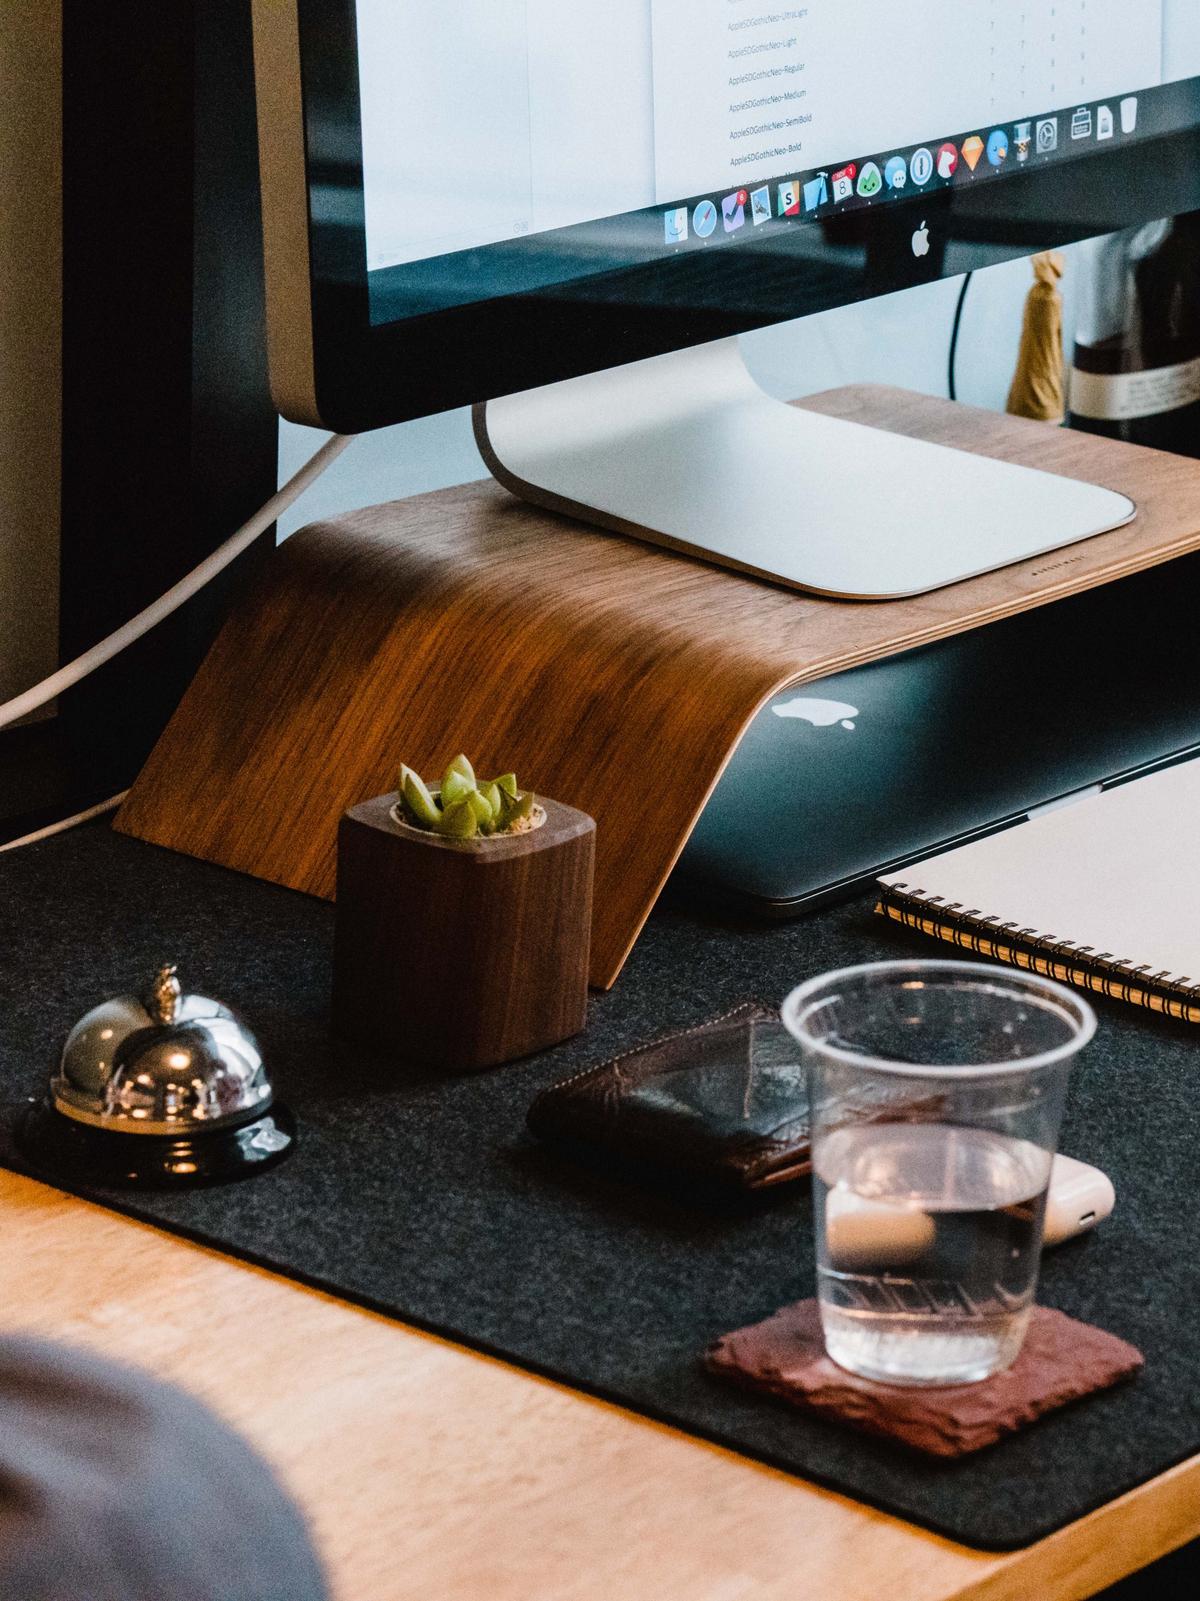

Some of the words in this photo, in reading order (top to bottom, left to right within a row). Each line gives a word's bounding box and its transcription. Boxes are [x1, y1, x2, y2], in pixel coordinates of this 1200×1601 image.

[729, 89, 807, 113] AppleSDGothicNeo-Medium
[729, 114, 813, 139] AppleSDGothicNeo-SemiBold
[730, 142, 802, 166] AppleSDGothicNeo-Bold
[785, 192, 792, 206] S
[839, 180, 846, 195] 8
